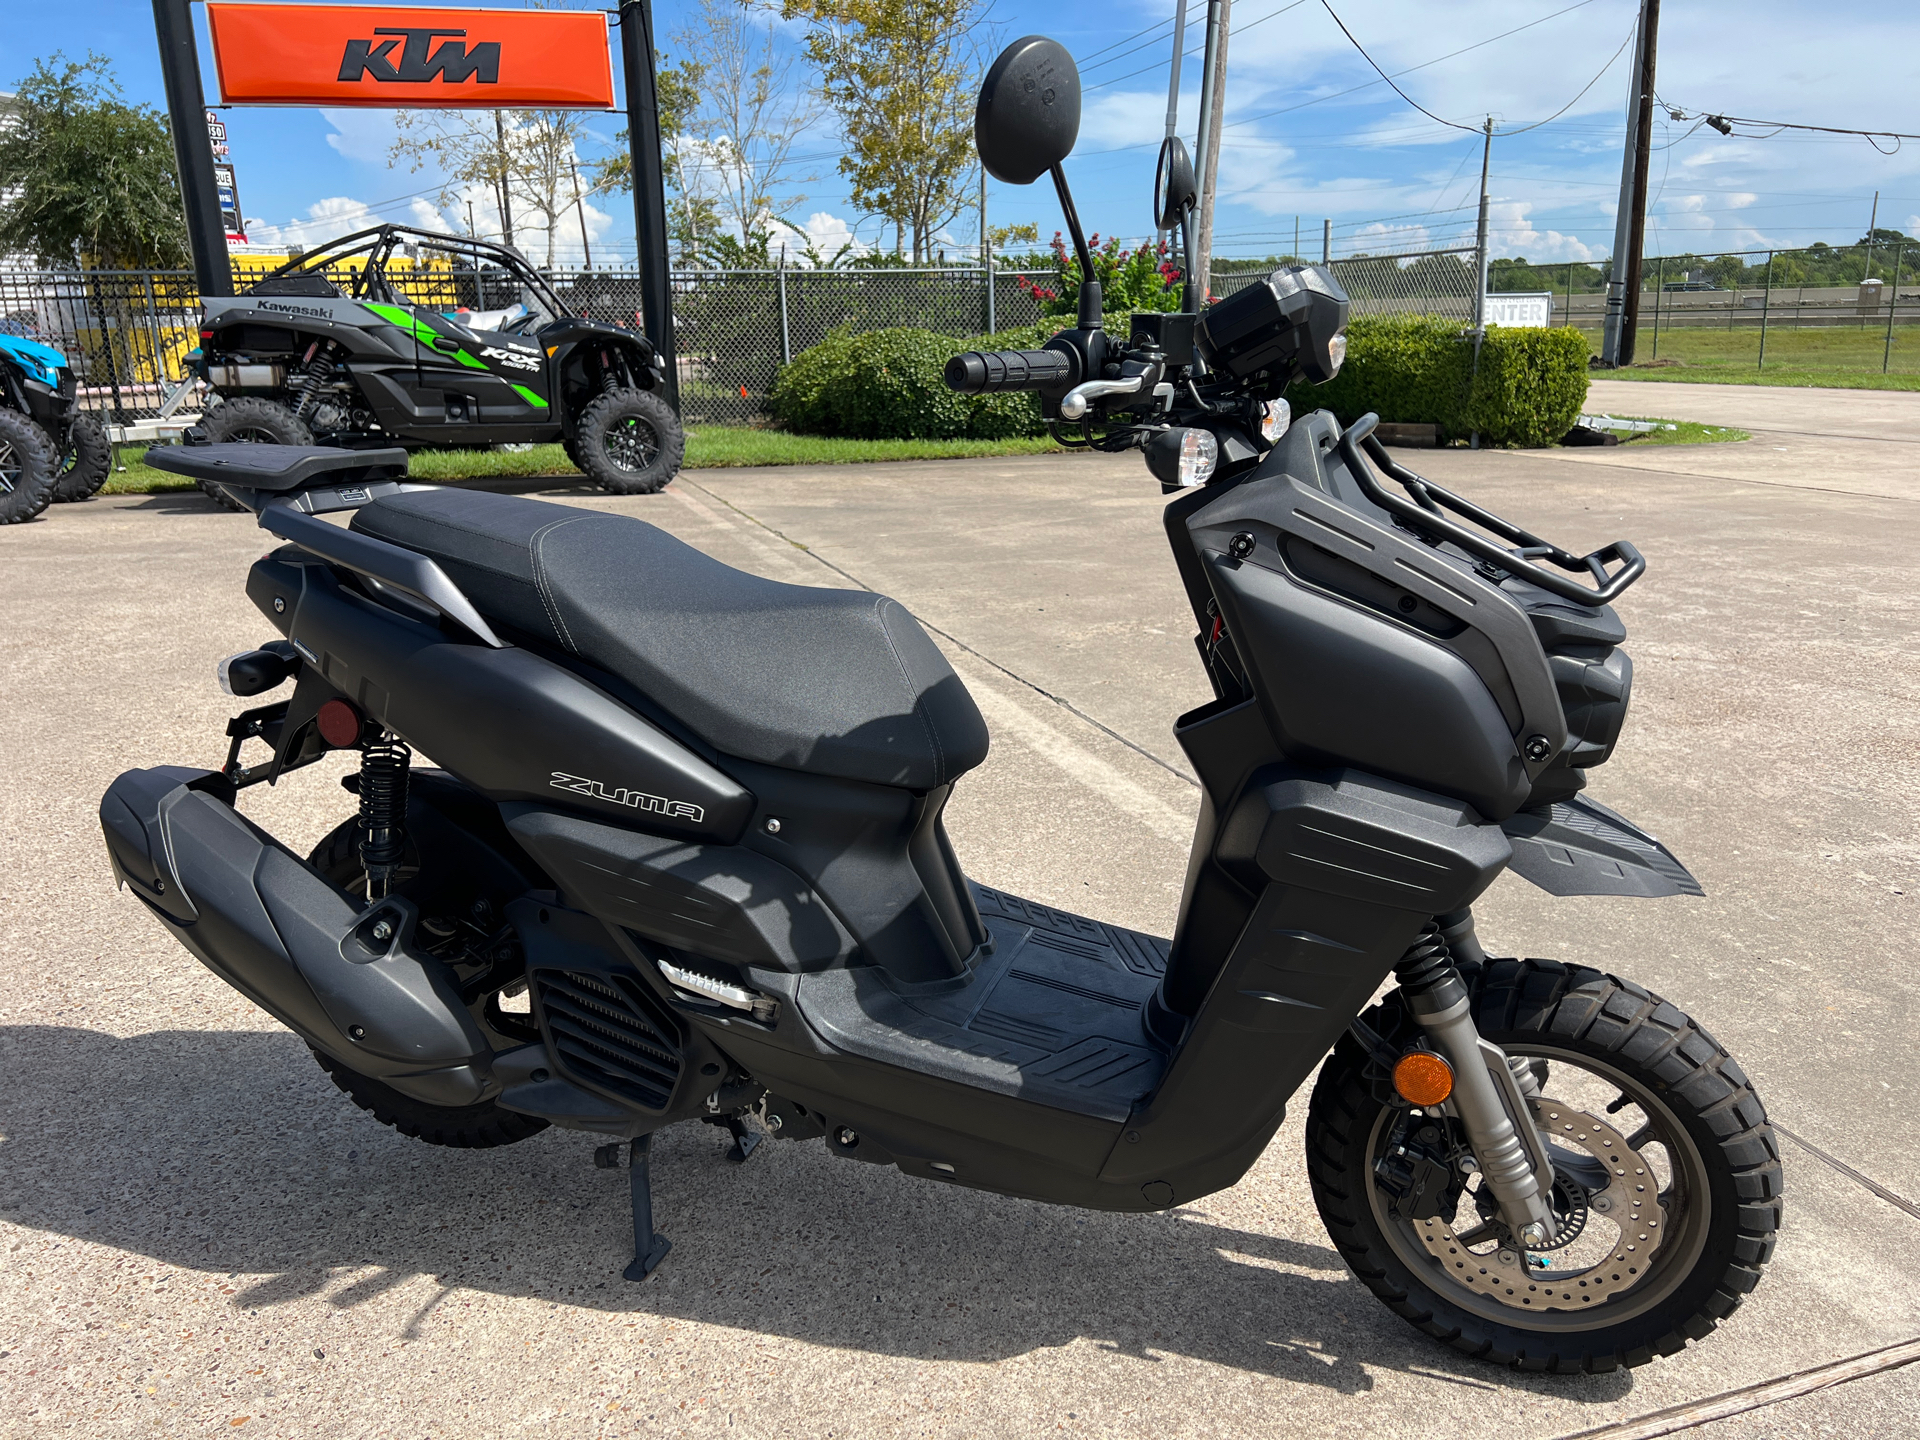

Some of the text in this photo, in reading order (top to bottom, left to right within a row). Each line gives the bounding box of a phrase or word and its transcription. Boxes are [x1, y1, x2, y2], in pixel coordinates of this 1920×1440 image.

[337, 27, 501, 83] KTM
[257, 300, 334, 319] Kawasaki
[480, 346, 542, 367] KRX
[549, 771, 705, 823] ZUMA
